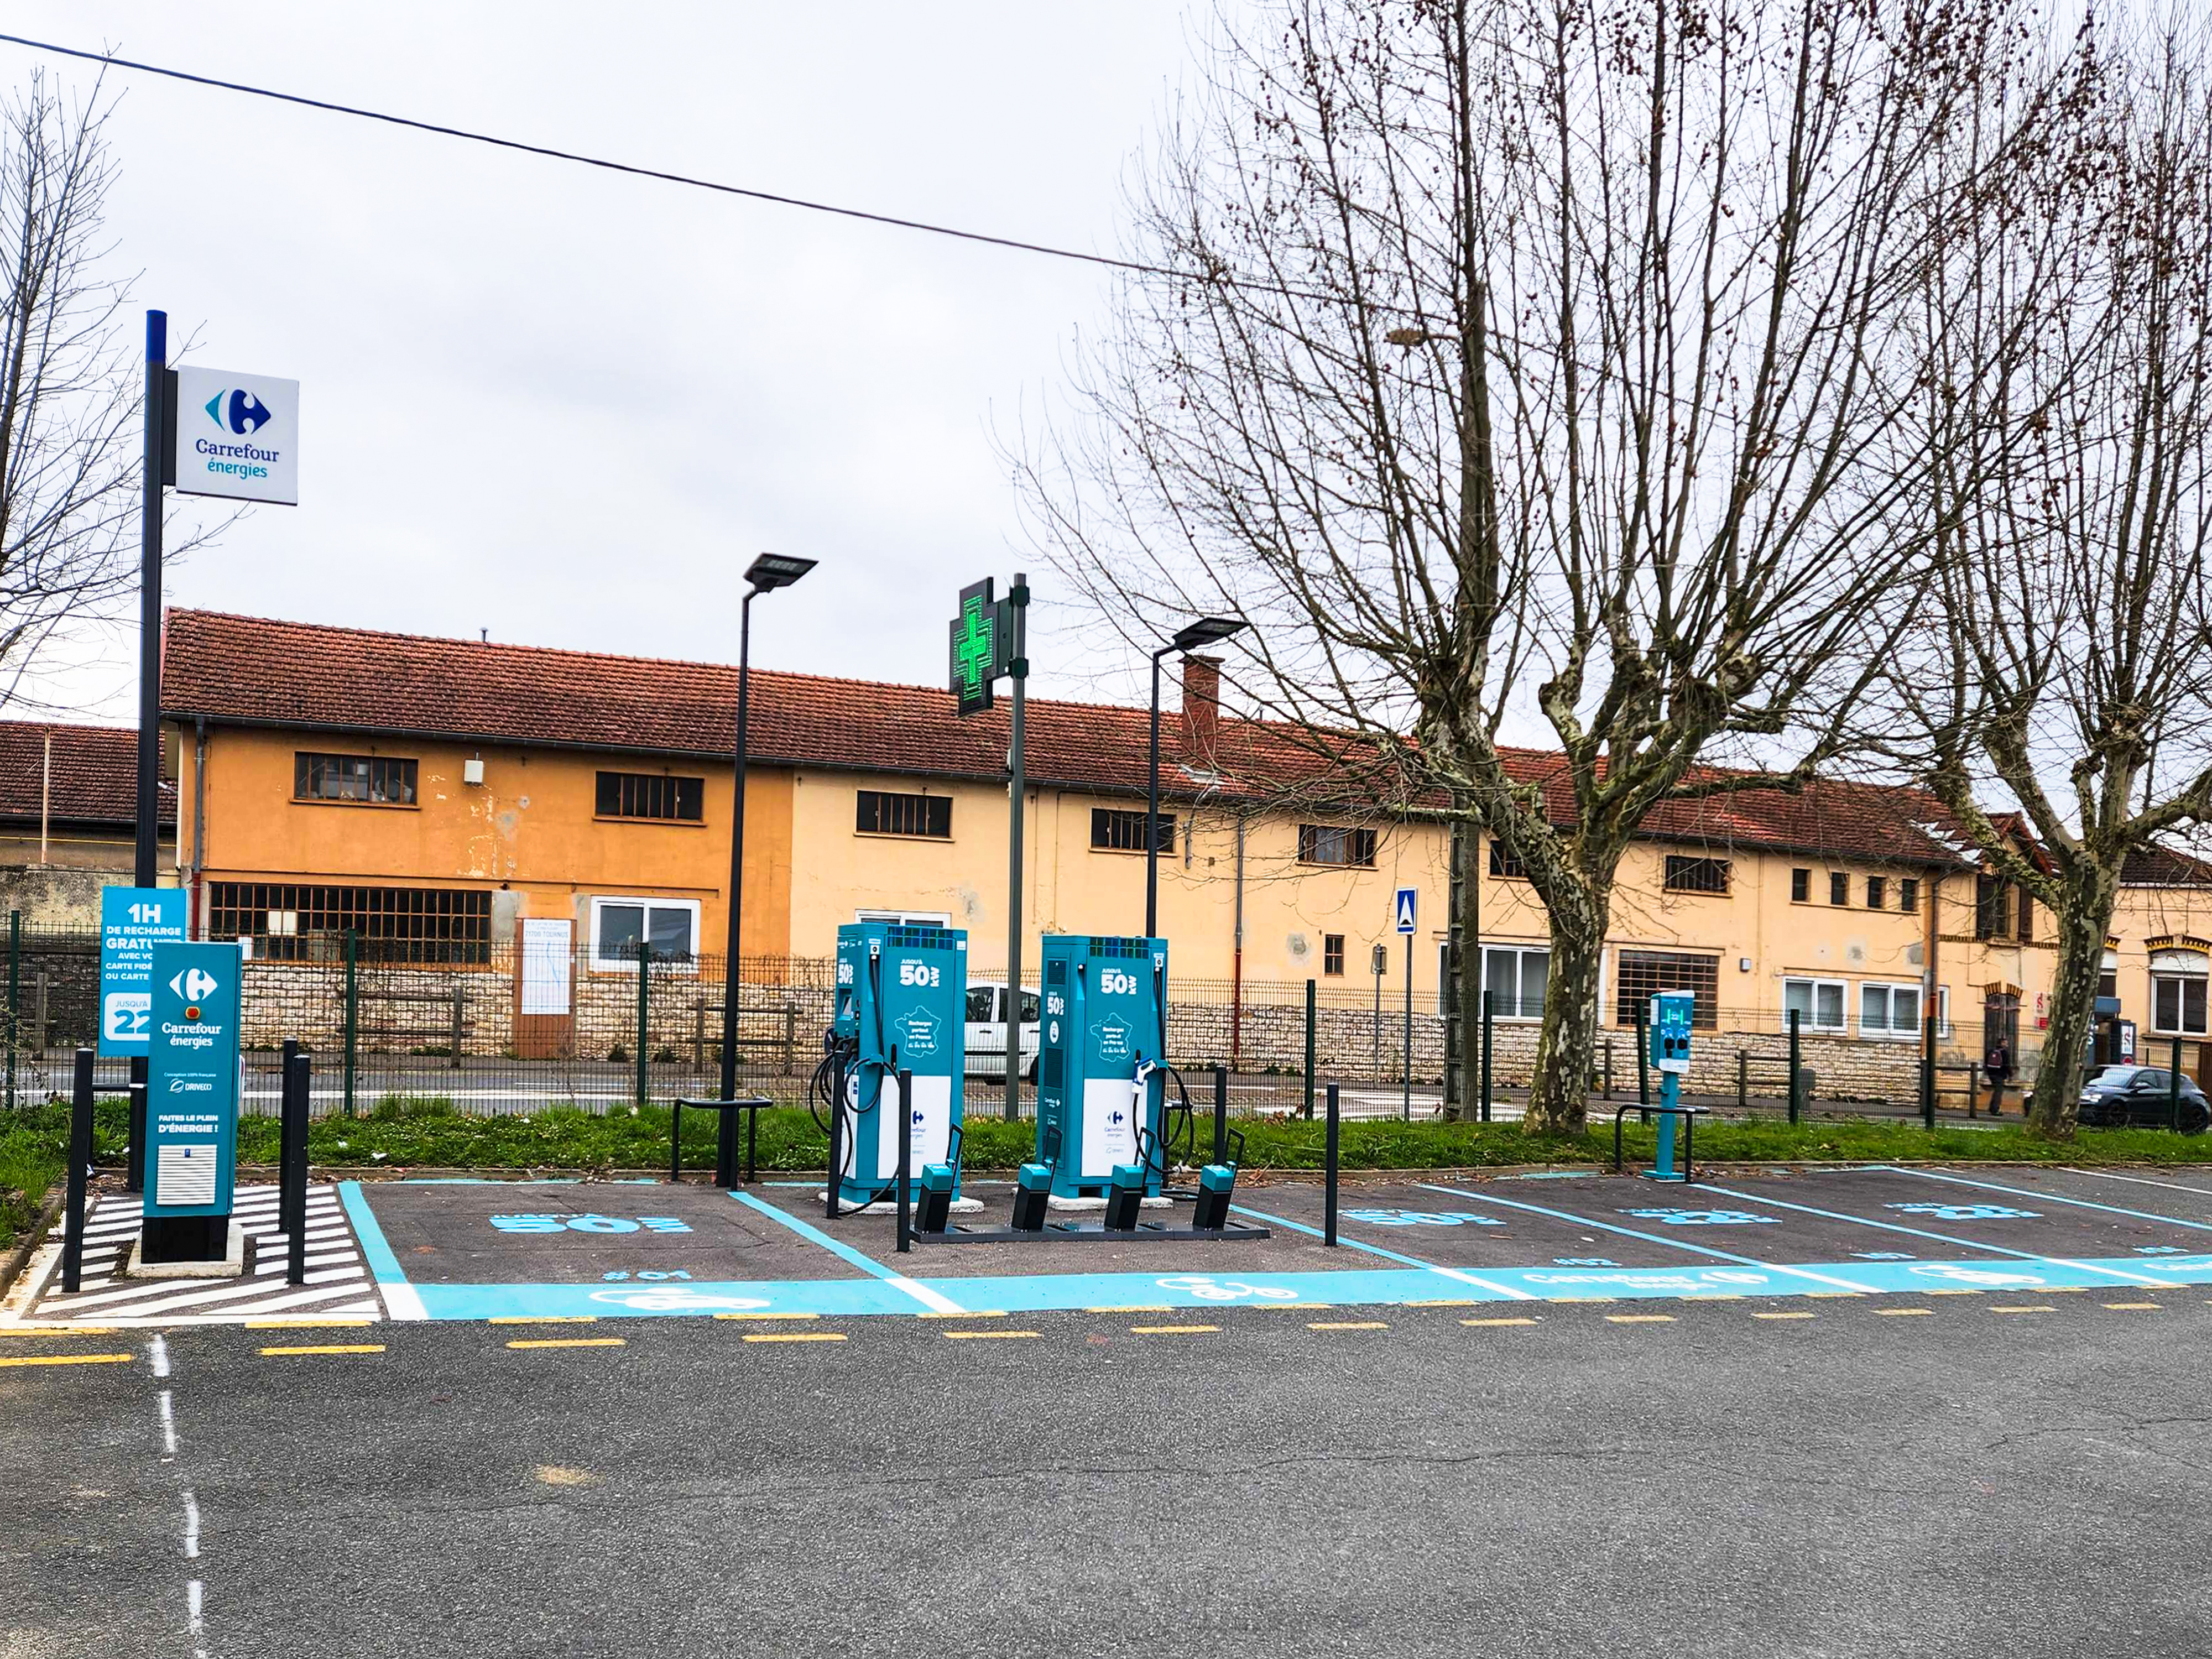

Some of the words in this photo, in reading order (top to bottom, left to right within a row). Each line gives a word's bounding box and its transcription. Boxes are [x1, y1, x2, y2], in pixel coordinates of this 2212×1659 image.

[196, 439, 279, 462] Carrefour
[207, 457, 268, 480] énergies
[127, 903, 161, 924] 1H
[107, 926, 121, 935] DE
[123, 926, 181, 936] RECHARGE
[134, 961, 152, 970] FIDÉ
[838, 964, 849, 984] 50
[900, 965, 930, 987] 50
[930, 966, 940, 987] kW
[1101, 974, 1128, 994] 50
[1128, 975, 1137, 995] kW
[1047, 996, 1060, 1015] 50
[114, 1009, 150, 1034] 22
[161, 1022, 222, 1034] Carrefour
[170, 1034, 213, 1050] énergies
[158, 1123, 213, 1133] D'ÉNERGIE
[214, 1125, 218, 1133] !
[489, 1217, 640, 1233] 50
[1342, 1212, 1464, 1226] 50
